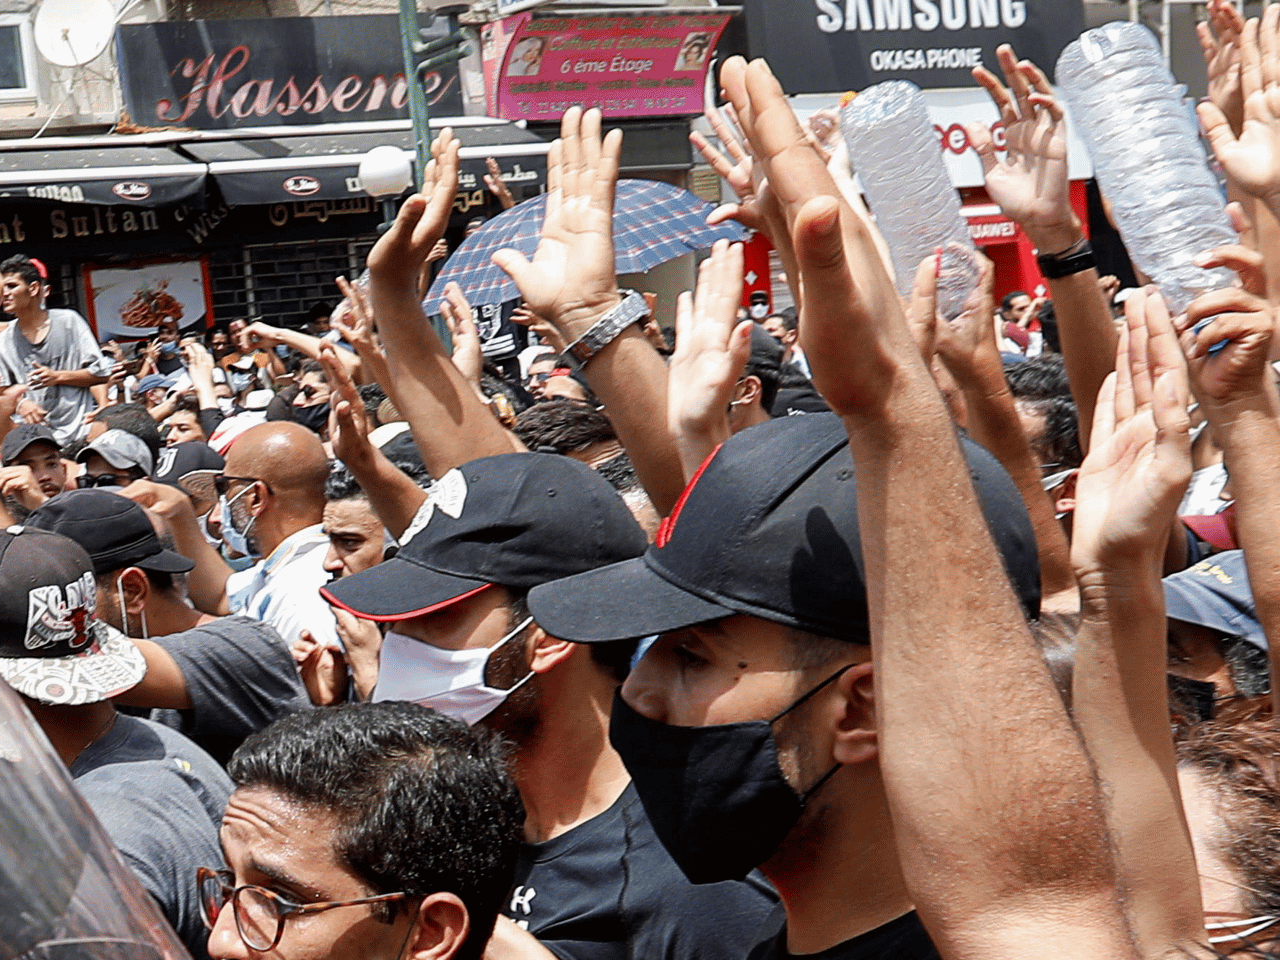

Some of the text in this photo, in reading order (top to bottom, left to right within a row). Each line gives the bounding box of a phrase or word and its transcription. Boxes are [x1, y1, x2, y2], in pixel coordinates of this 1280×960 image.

[817, 0, 1026, 33] SAMSUNG
[560, 59, 571, 74] 6
[156, 45, 457, 123] Hassene
[49, 205, 160, 240] Sultan
